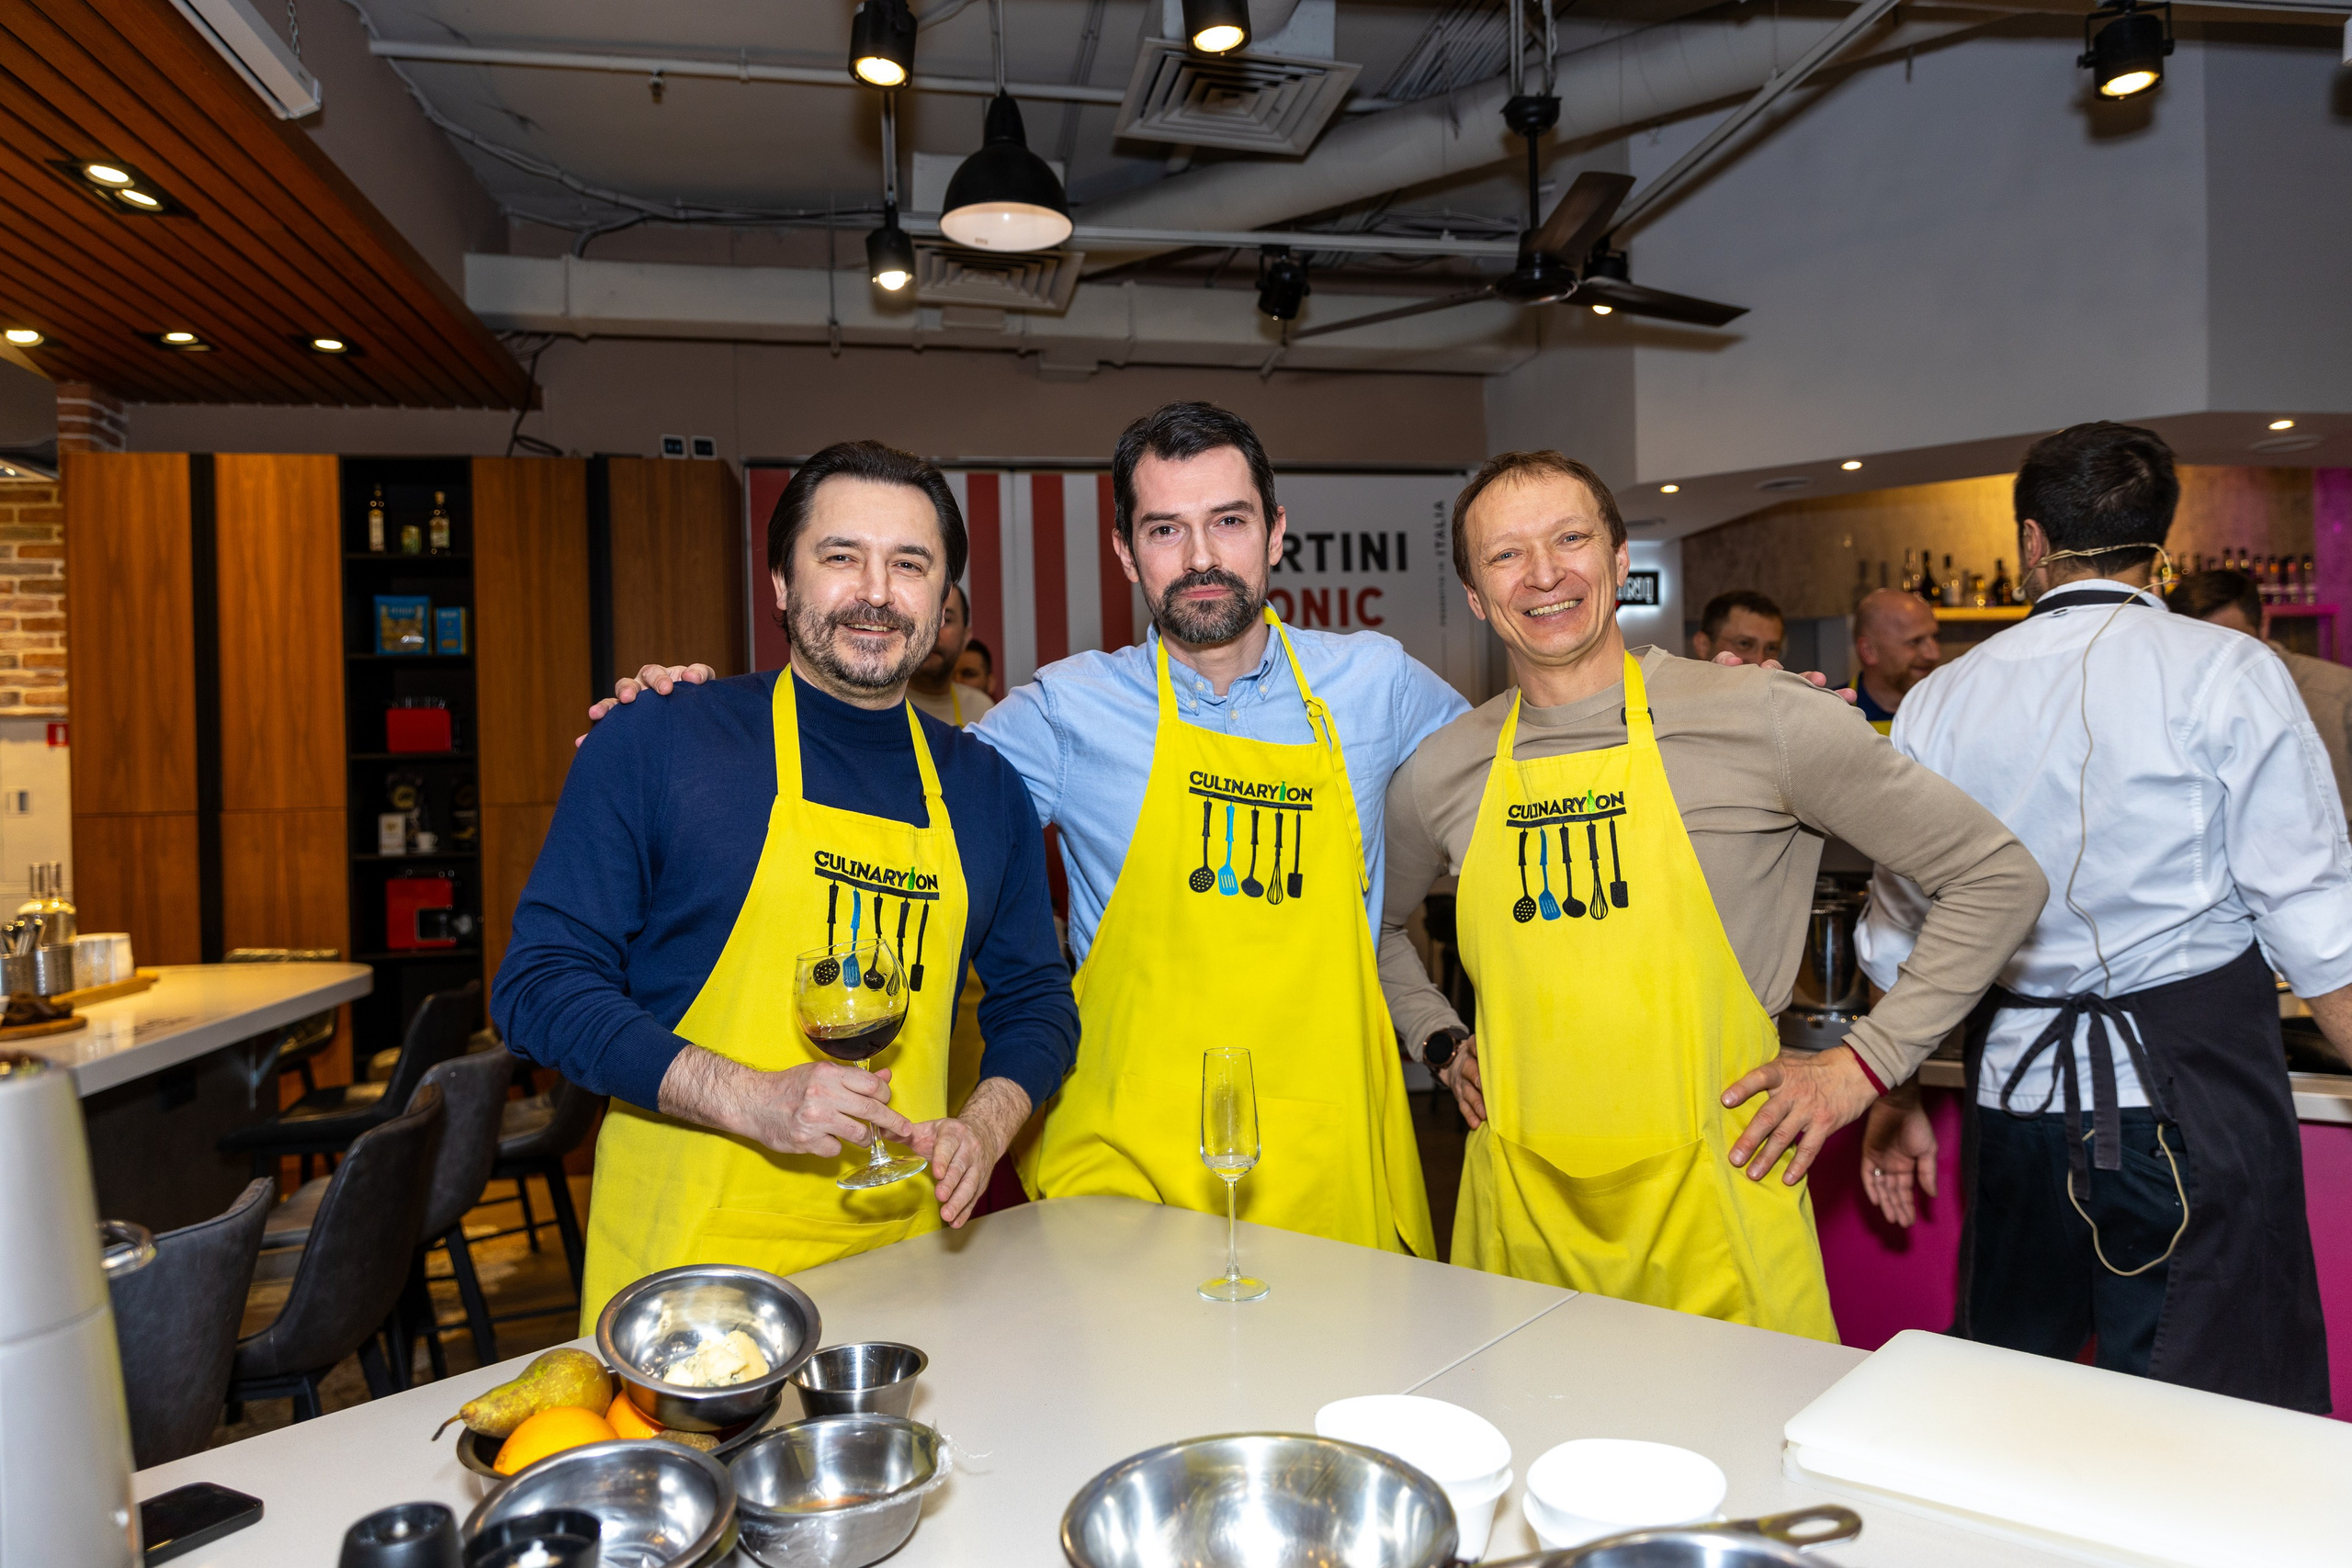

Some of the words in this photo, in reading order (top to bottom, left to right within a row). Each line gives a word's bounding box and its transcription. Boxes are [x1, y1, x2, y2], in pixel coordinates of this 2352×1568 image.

[1432, 500, 1448, 557] ITALIA
[1272, 532, 1408, 572] RTINI
[1267, 587, 1385, 627] ONIC
